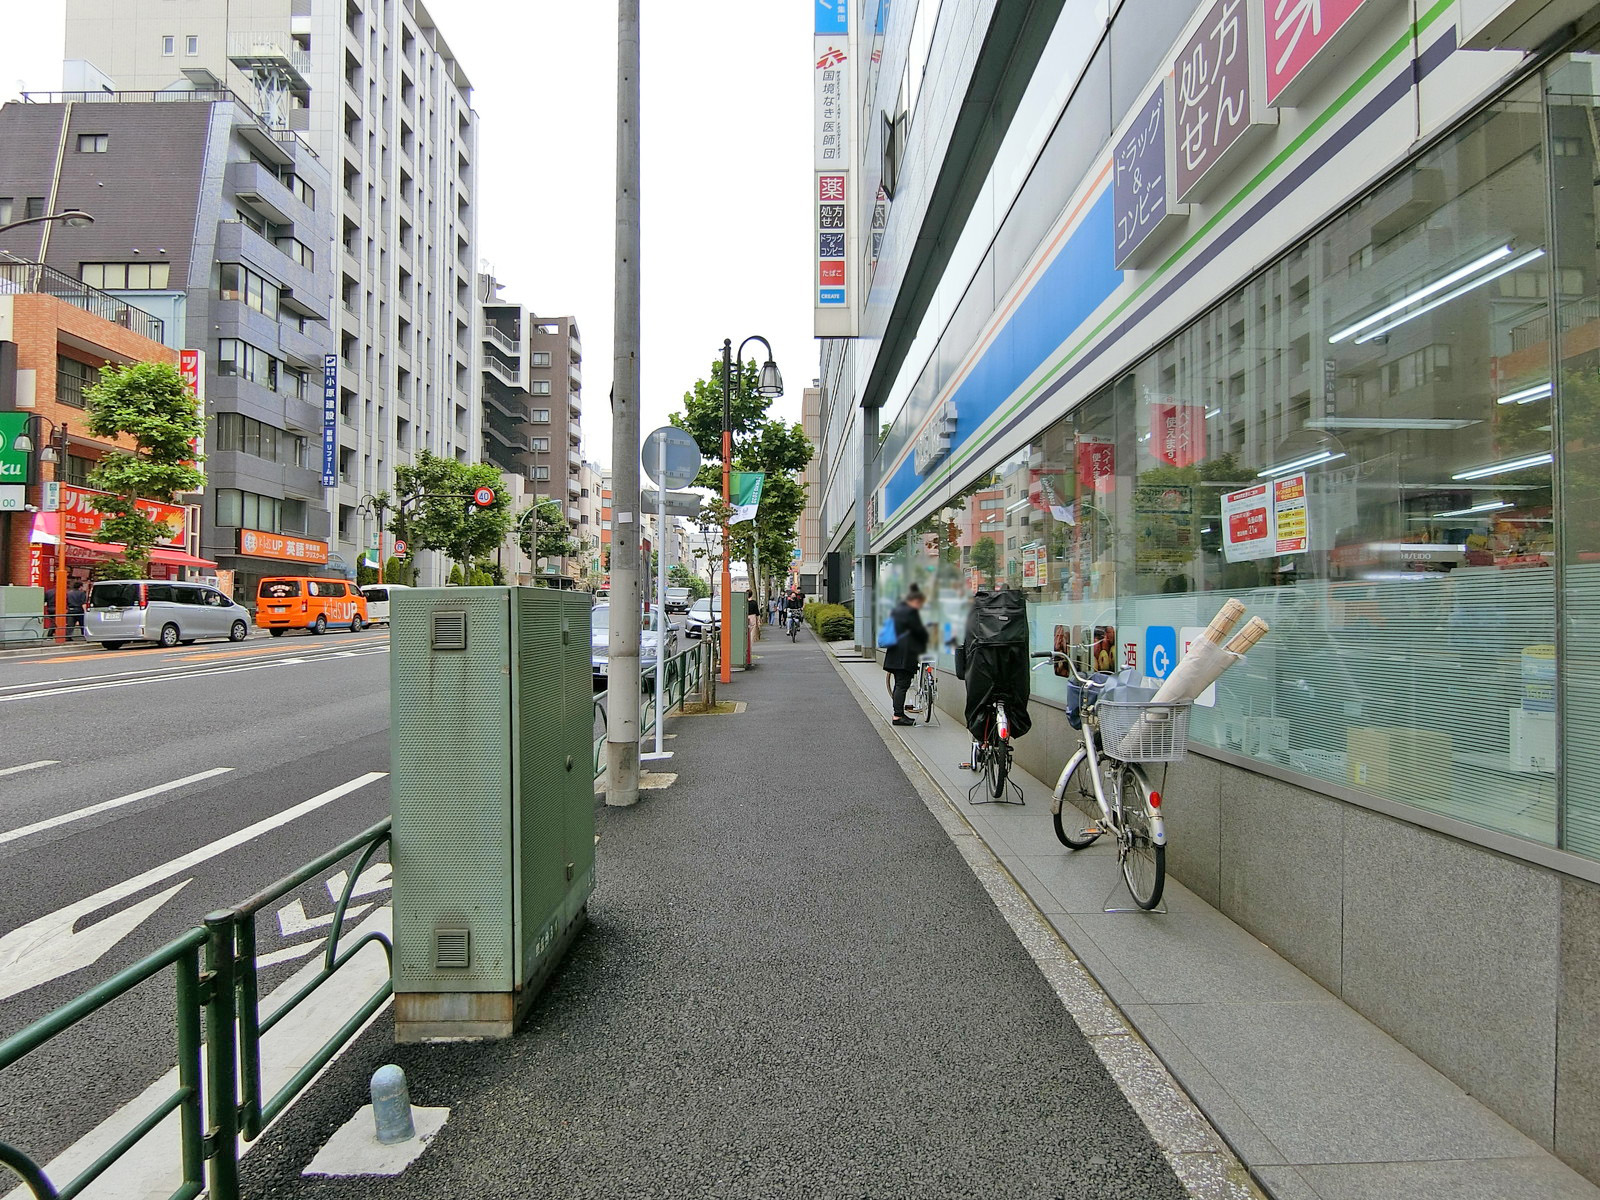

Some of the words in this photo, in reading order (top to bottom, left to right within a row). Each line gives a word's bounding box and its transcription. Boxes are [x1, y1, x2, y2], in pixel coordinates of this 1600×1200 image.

[1179, 0, 1241, 123] 処方
[822, 70, 836, 160] 国境なき医師団
[1181, 84, 1245, 172] せん
[1115, 97, 1163, 188] ドラッグ
[821, 178, 843, 199] 薬
[1132, 166, 1143, 194] &
[821, 206, 843, 217] 処方
[821, 217, 843, 227] せん
[1117, 174, 1165, 250] コンビニ
[820, 234, 843, 243] ドラッグ
[821, 248, 843, 256] コンビニ
[1179, 411, 1192, 451] ペイペイ
[325, 444, 333, 475] リフォーム
[478, 492, 489, 501] 40
[272, 540, 283, 552] UP
[286, 541, 304, 557] 英語
[323, 597, 342, 620] kids
[343, 602, 358, 619] UP
[1123, 642, 1137, 670] 酒
